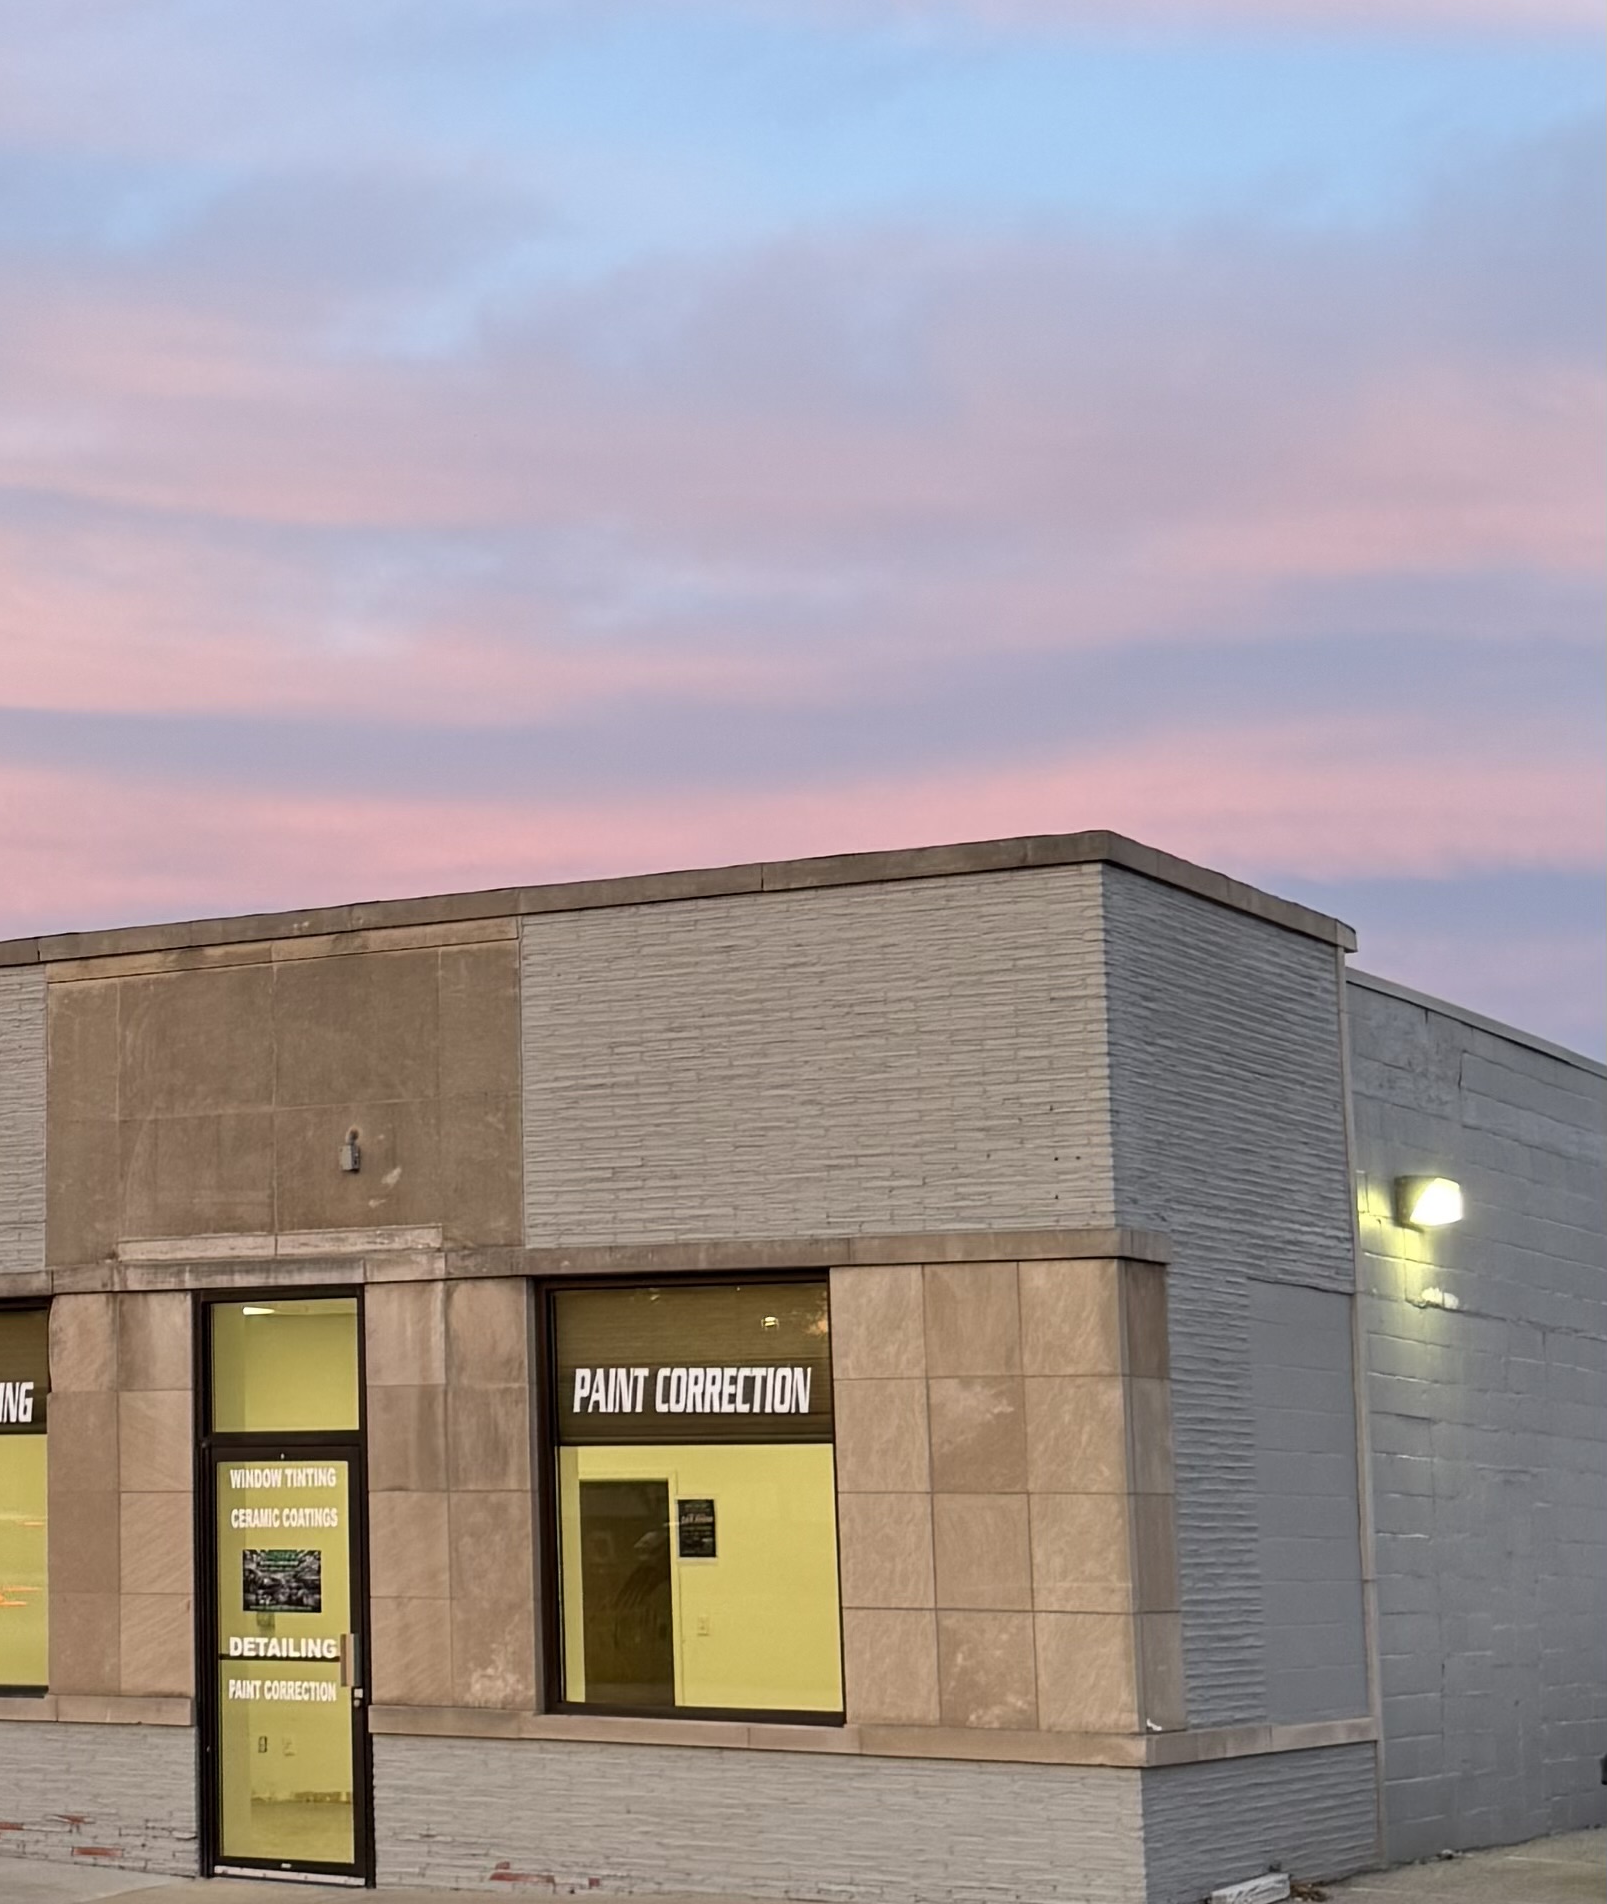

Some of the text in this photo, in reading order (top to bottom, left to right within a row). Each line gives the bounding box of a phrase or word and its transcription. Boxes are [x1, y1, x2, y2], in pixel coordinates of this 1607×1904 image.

[572, 1366, 811, 1414] PAINT CORRECTION
[230, 1467, 336, 1489] WINDOW TINTING
[231, 1507, 338, 1528] CERAMIC COATINGS
[229, 1636, 337, 1658] DETAILING
[229, 1679, 337, 1702] PAINT CORRECTION
